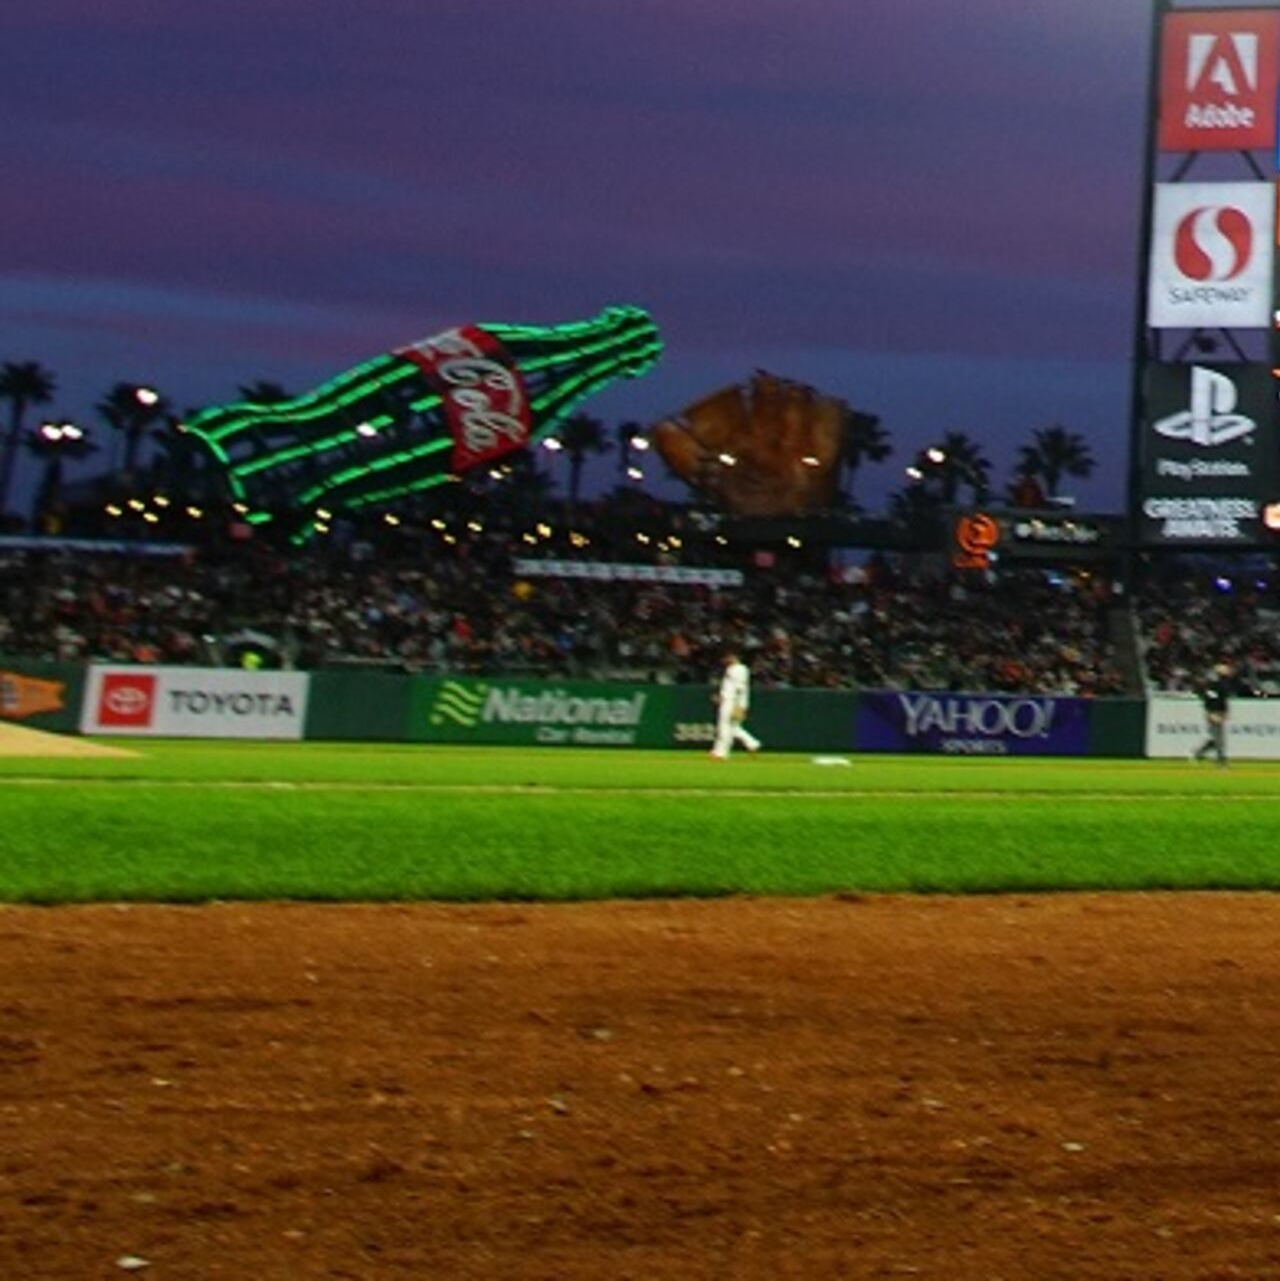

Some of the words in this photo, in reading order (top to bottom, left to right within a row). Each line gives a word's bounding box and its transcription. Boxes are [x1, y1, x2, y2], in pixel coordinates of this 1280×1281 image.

[1185, 103, 1255, 129] Adobe
[1168, 286, 1253, 304] SAFEWAY
[167, 689, 296, 718] TOYOTA
[482, 686, 647, 725] National
[899, 694, 1056, 739] YAHOO!
